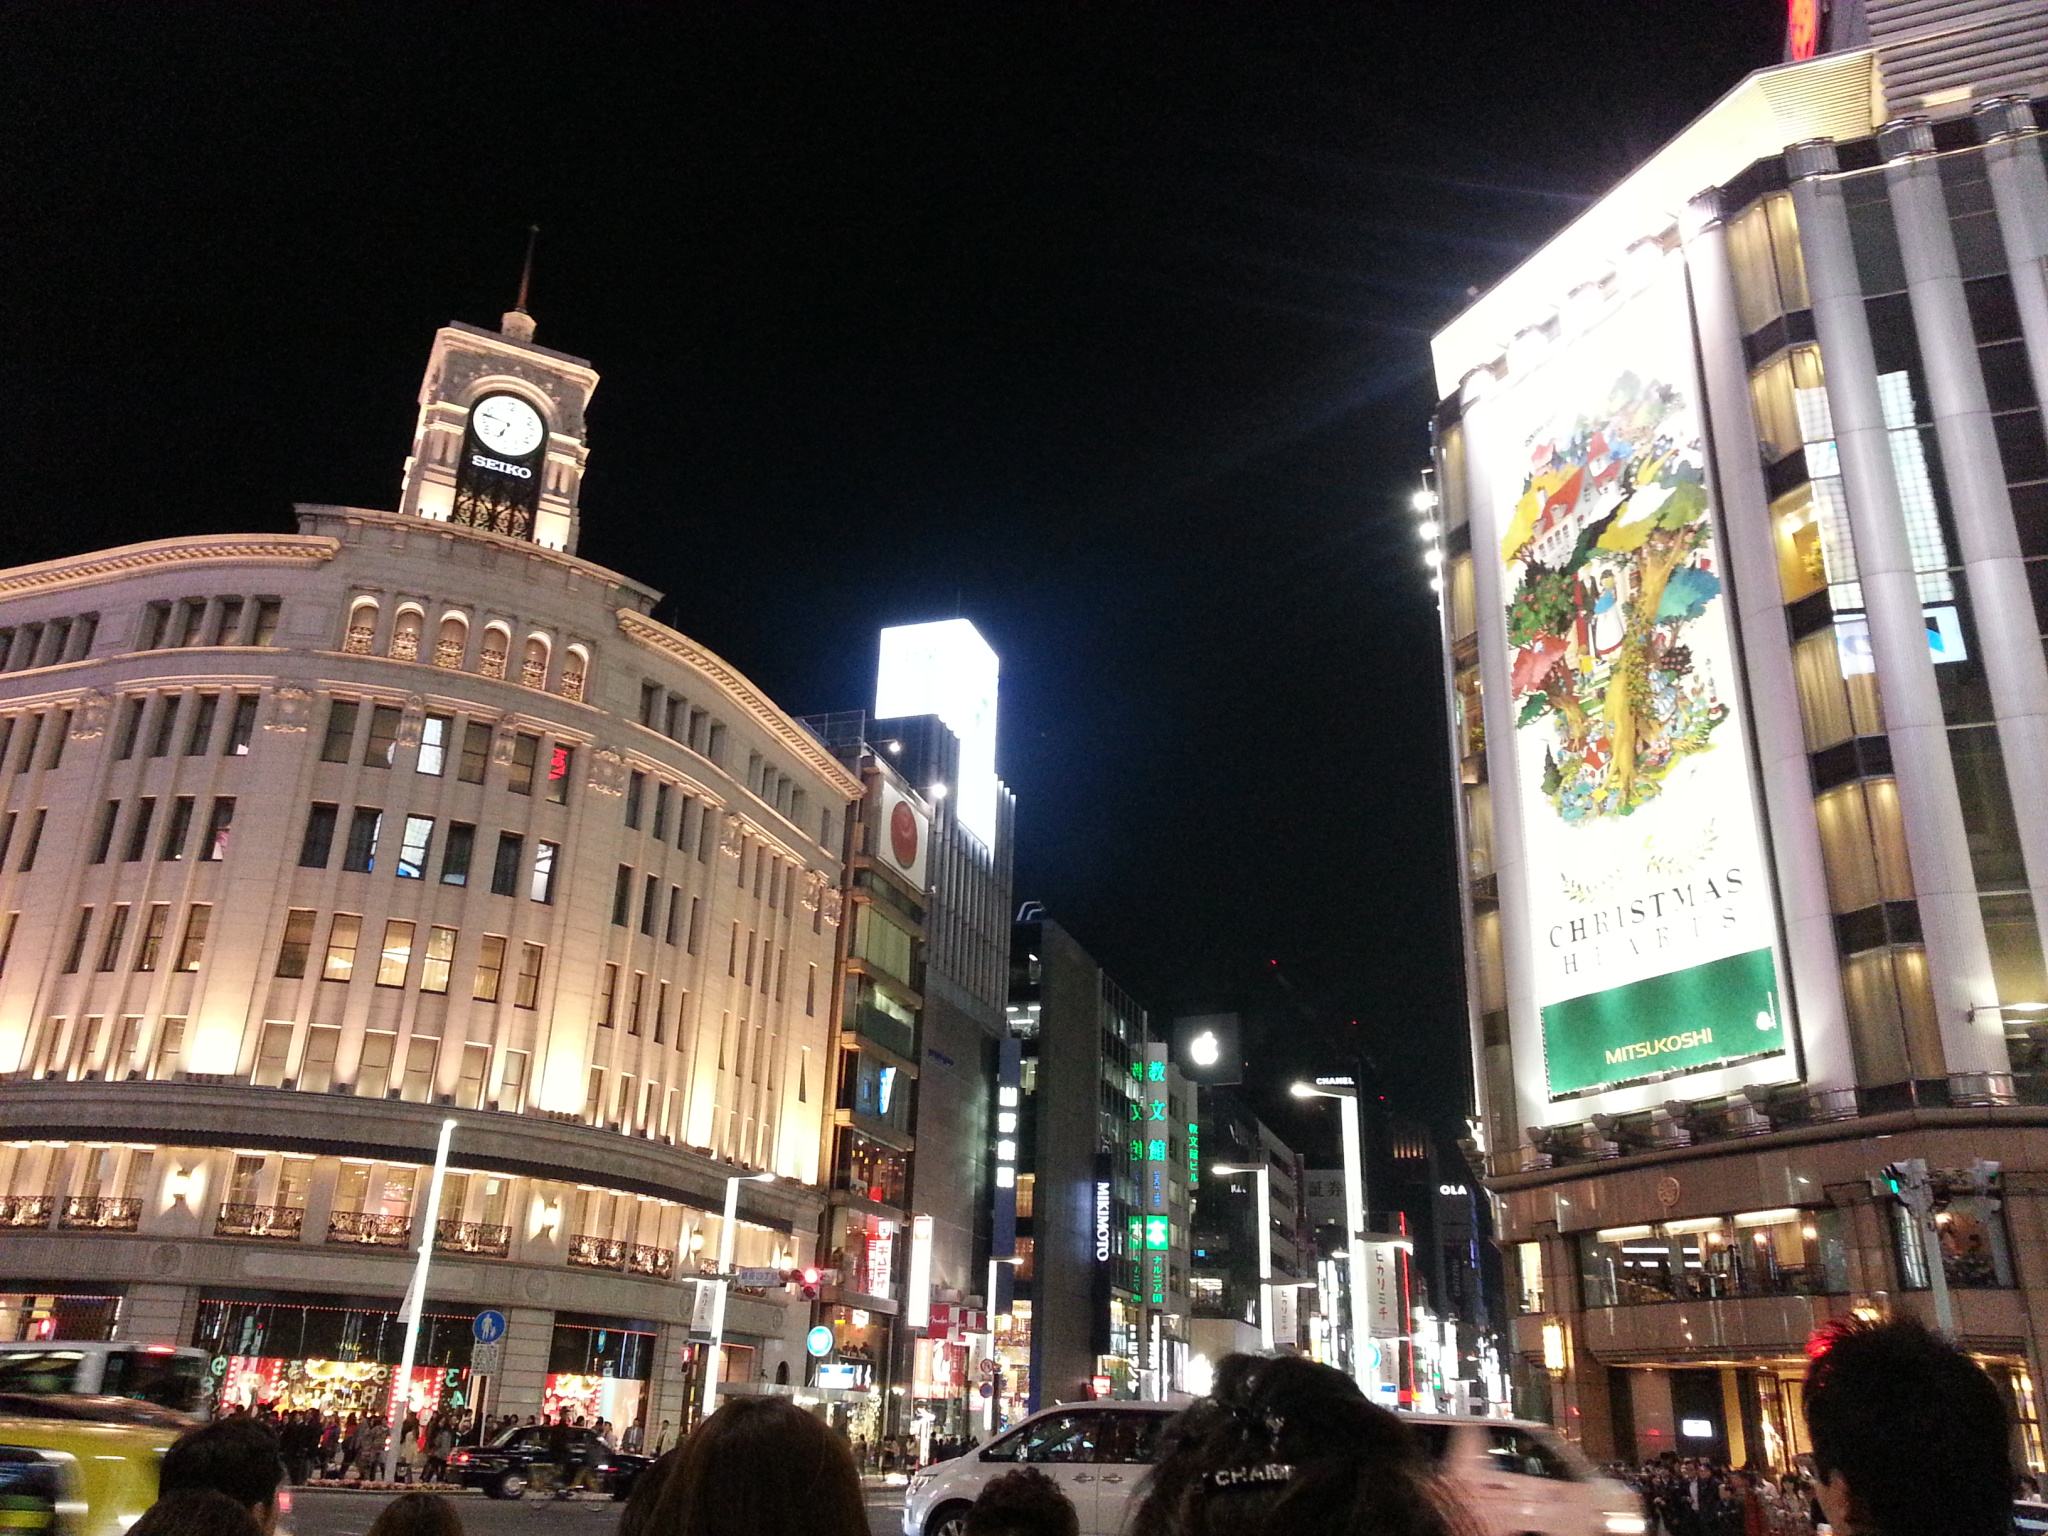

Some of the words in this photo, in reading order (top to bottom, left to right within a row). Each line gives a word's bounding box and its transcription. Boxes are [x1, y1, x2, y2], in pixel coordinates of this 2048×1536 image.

[471, 455, 532, 479] SEIKO
[1549, 868, 1744, 948] CHRISTMAS
[1605, 1027, 1713, 1064] MITSUKOSHI
[1315, 1077, 1355, 1085] CHANEL
[1148, 1061, 1166, 1161] 教文館
[1096, 1182, 1110, 1262] MIKIMOTO
[1147, 1220, 1166, 1246] 本
[1375, 1249, 1388, 1320] ヒカリミチ
